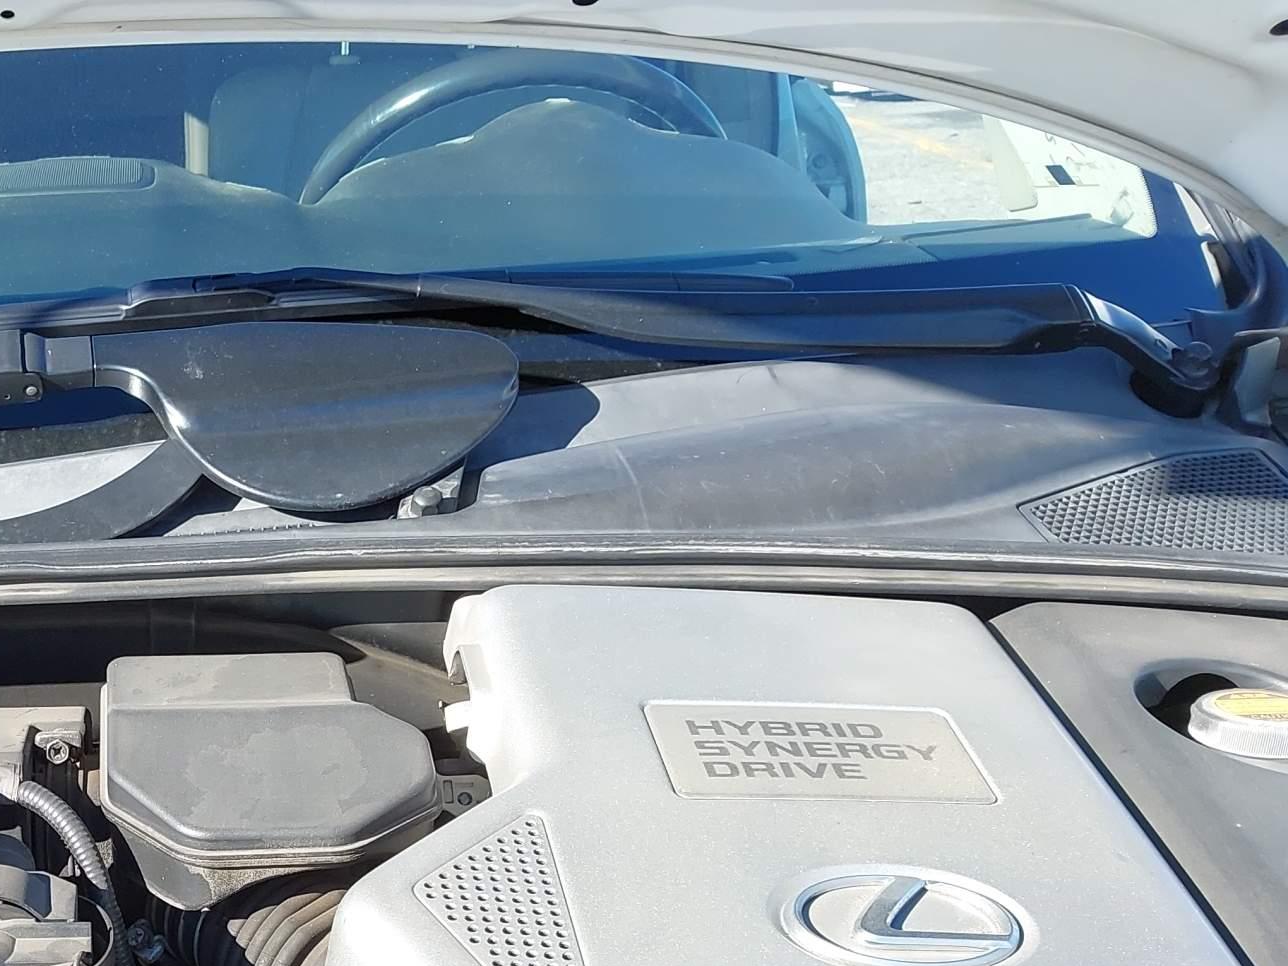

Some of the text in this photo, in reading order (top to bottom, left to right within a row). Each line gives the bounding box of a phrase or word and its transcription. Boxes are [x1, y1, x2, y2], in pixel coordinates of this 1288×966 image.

[685, 719, 884, 739] HYBRID
[693, 740, 937, 761] SYNERGY
[703, 761, 868, 780] DRIVE
